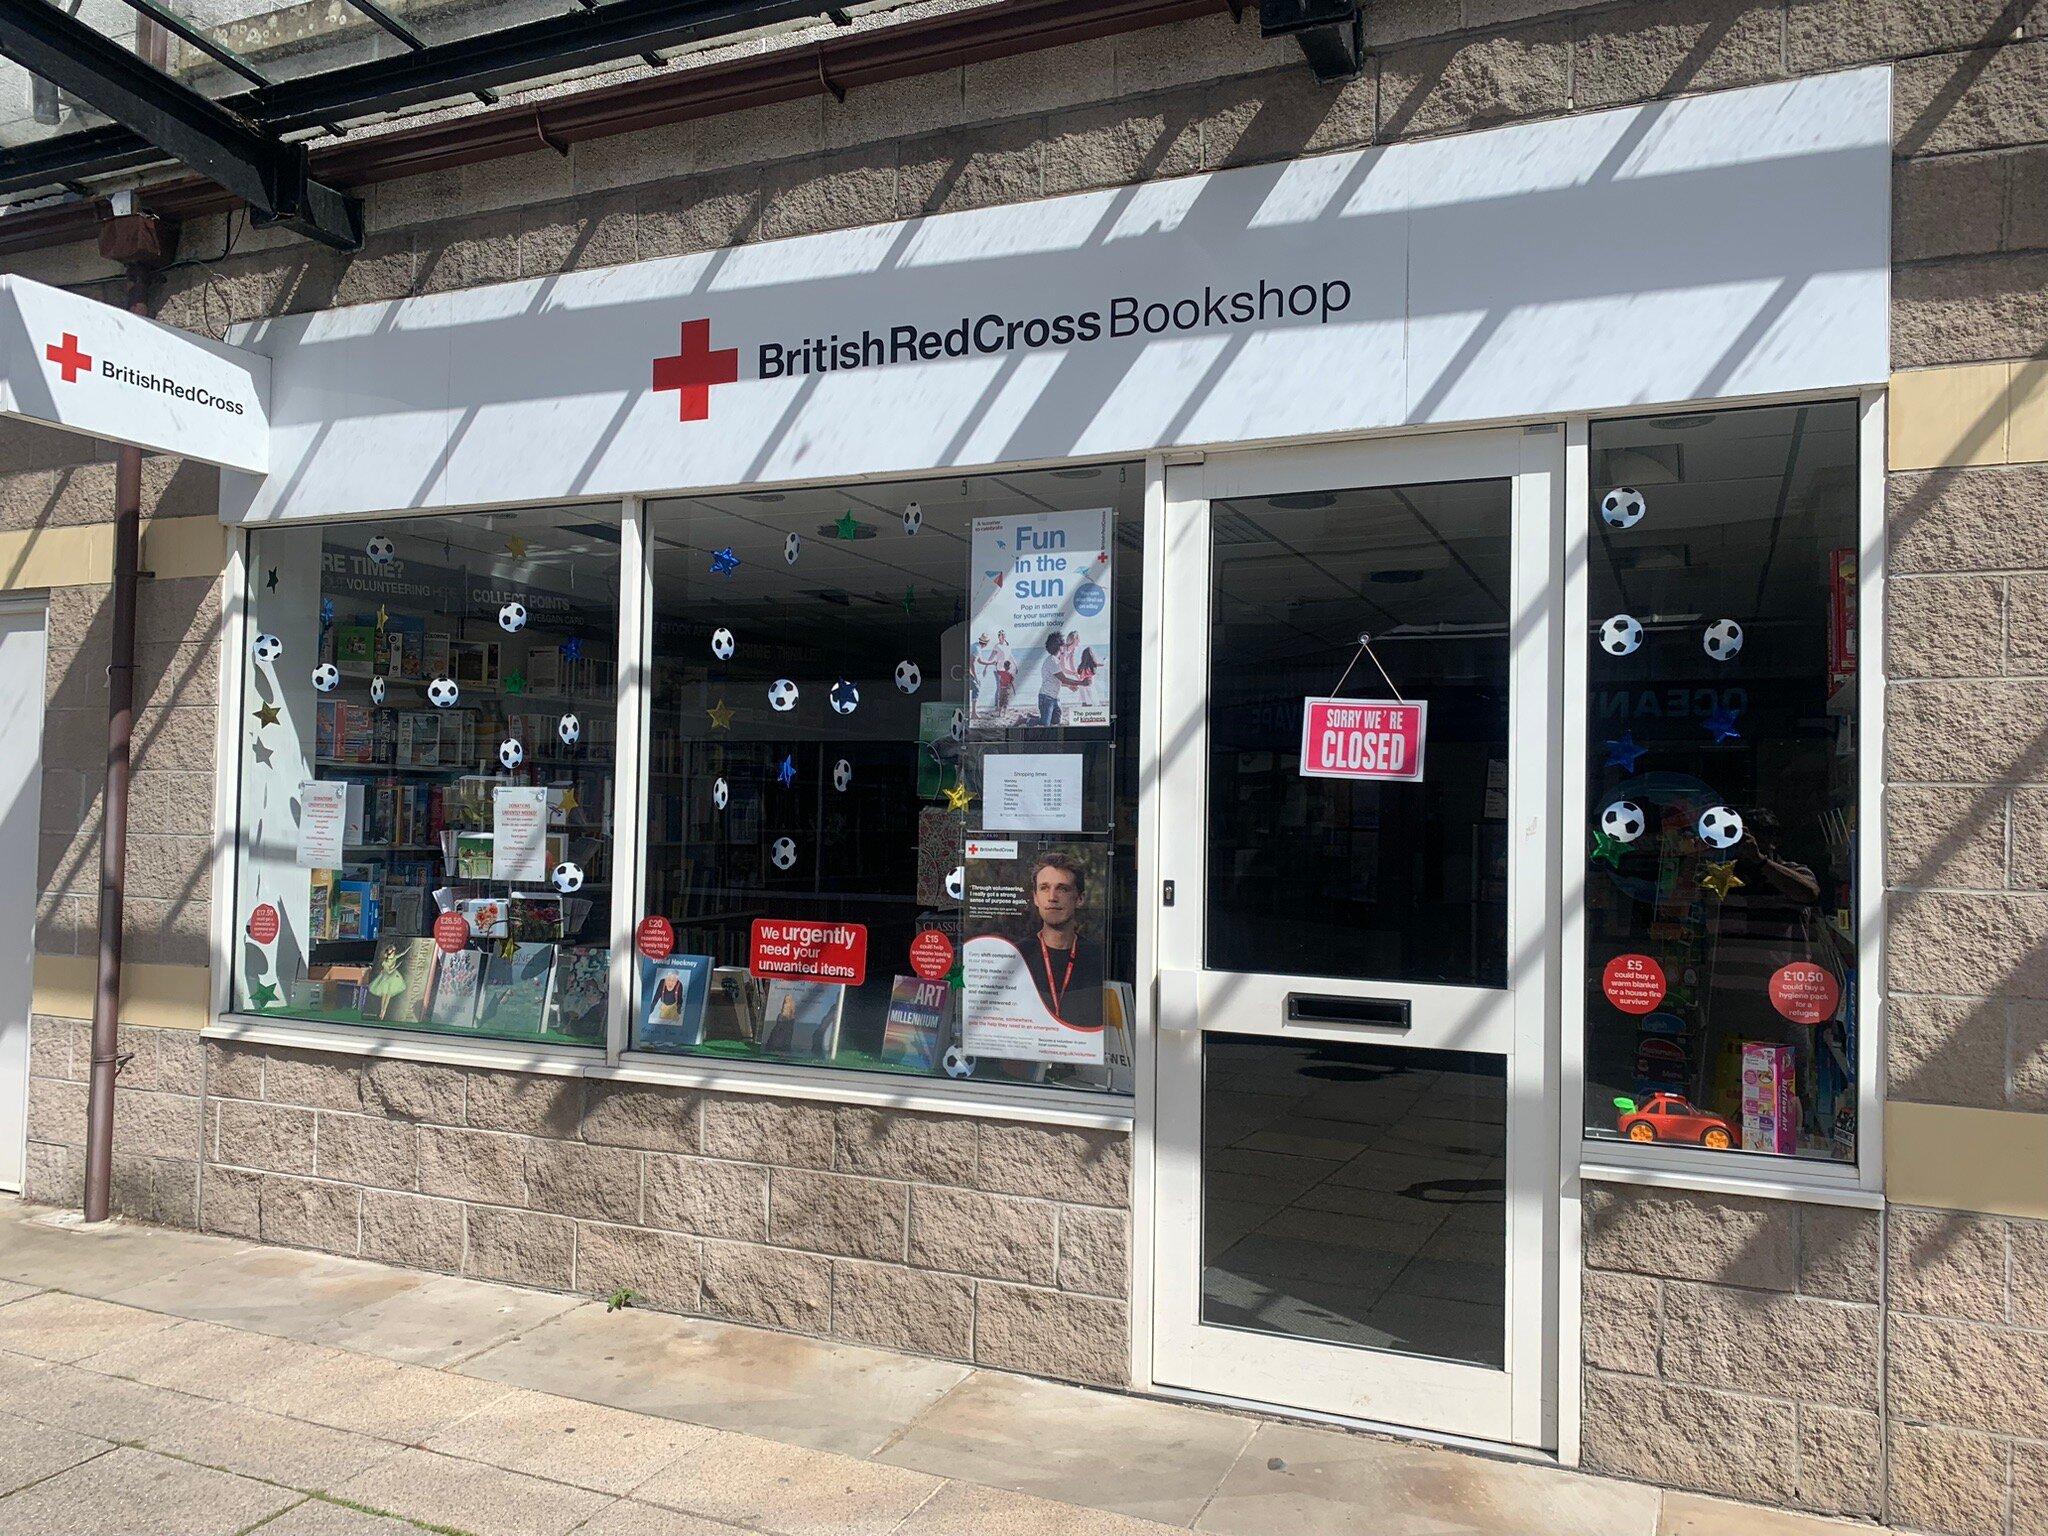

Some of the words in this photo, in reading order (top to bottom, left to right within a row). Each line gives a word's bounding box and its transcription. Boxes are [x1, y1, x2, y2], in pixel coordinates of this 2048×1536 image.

[758, 310, 1101, 379] BritishRedCross
[1110, 279, 1350, 338] Bookshop
[102, 361, 244, 416] BritishRedCross
[1016, 526, 1065, 551] Fun
[1015, 557, 1030, 573] in
[1036, 555, 1066, 572] the
[346, 578, 430, 596] VOLUNTEERING
[1015, 578, 1064, 598] sun
[473, 589, 527, 605] COLLECT
[530, 595, 570, 610] POINTS
[1014, 620, 1044, 628] essentials
[1326, 708, 1362, 728] SORRY
[1321, 730, 1405, 770] CLOSED
[649, 919, 663, 928] £20
[760, 926, 780, 940] We
[782, 926, 856, 950] urgently
[926, 935, 939, 943] £15
[759, 944, 790, 956] need
[793, 947, 820, 960] your
[671, 959, 698, 969] Hockney
[758, 960, 818, 974] unwanted
[820, 962, 855, 978] items
[1627, 960, 1643, 971] £5
[1632, 981, 1659, 989] blanket
[1635, 972, 1649, 981] buy
[1783, 971, 1824, 982] £10.50
[914, 983, 945, 1007] ART
[1625, 989, 1648, 997] house
[1779, 992, 1809, 1000] hygiene
[1804, 984, 1819, 992] buy
[890, 1009, 940, 1028] MILLENNIUM
[1789, 1010, 1820, 1018] refugee
